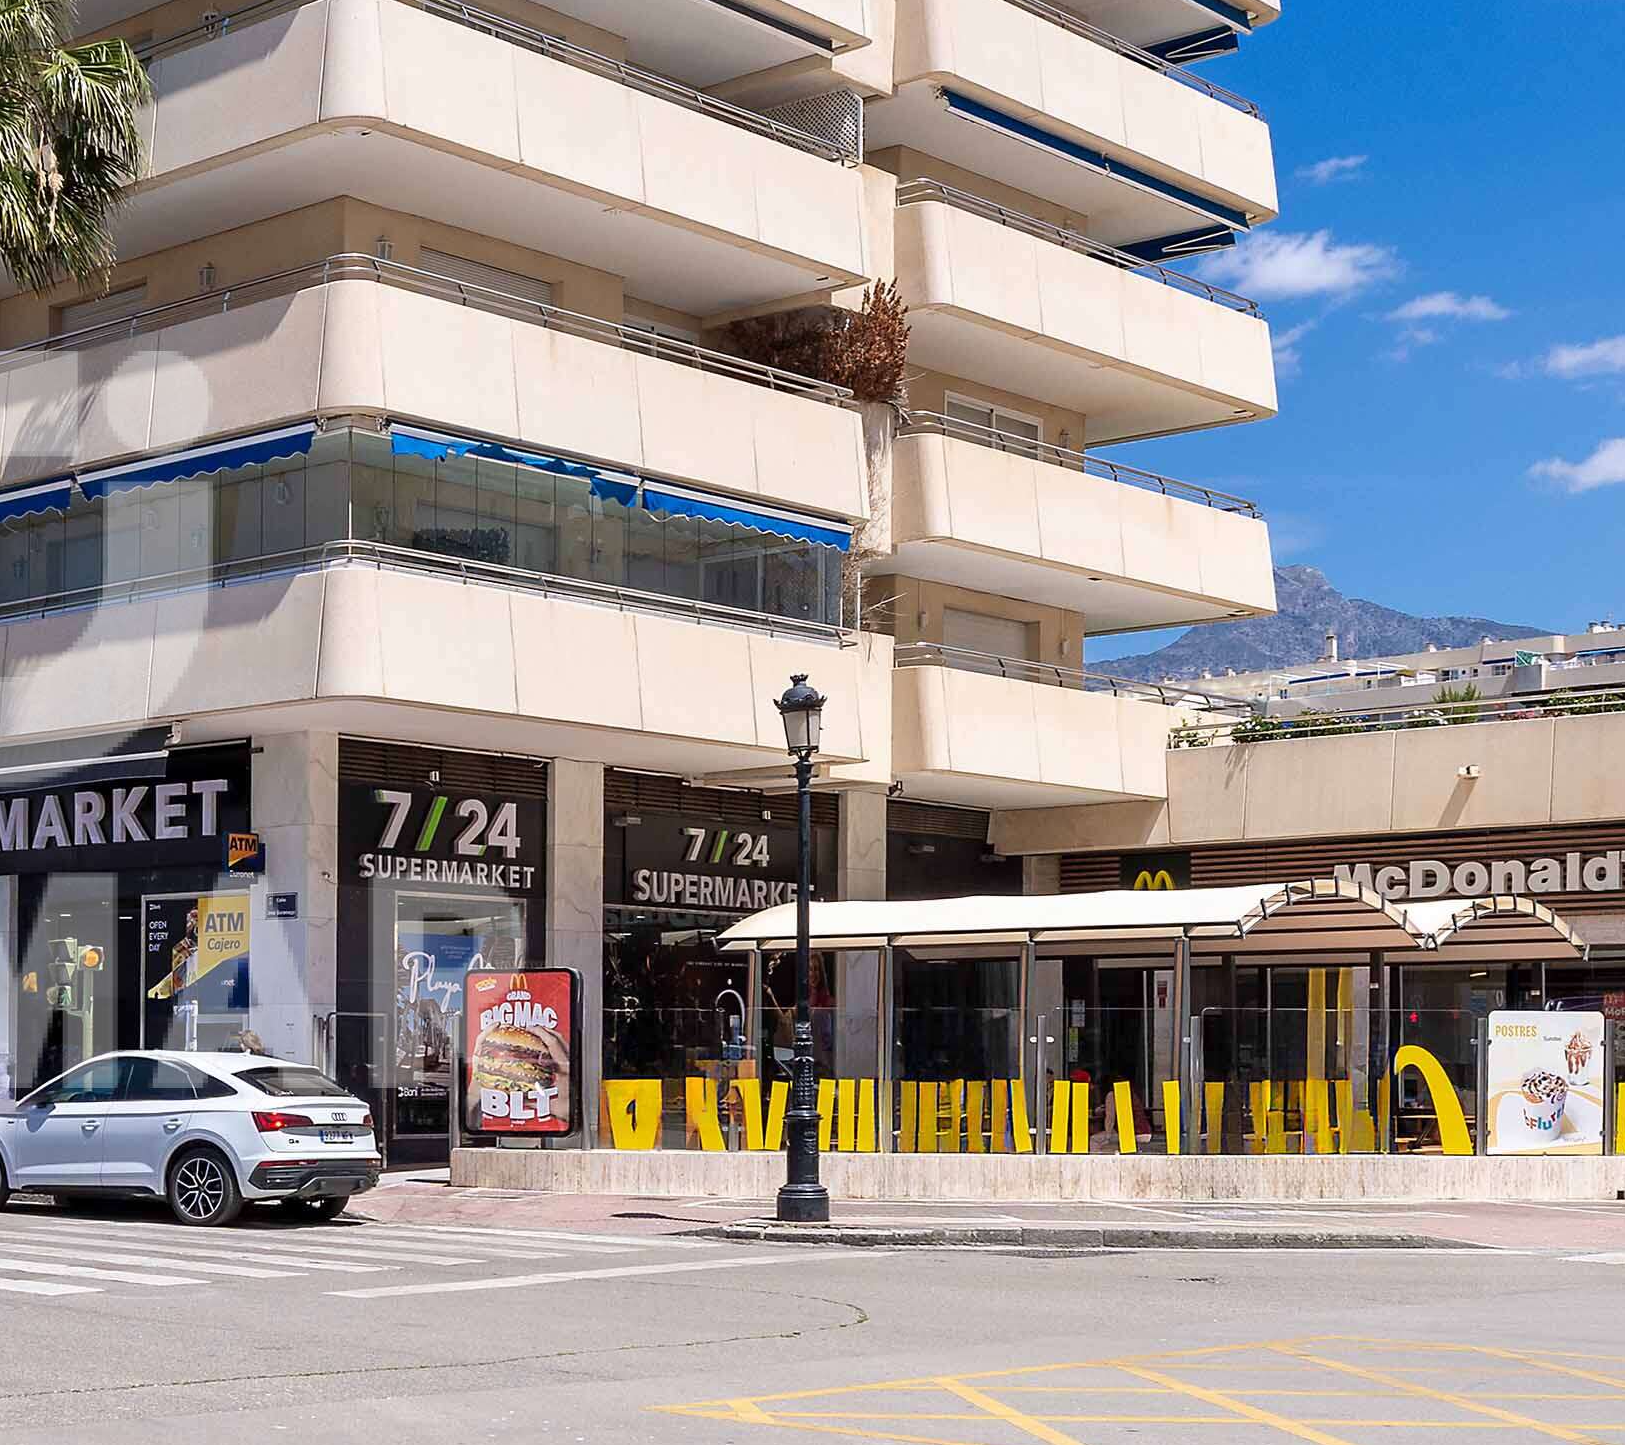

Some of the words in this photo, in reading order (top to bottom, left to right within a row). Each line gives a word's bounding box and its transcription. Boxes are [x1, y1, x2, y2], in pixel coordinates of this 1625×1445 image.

[230, 837, 257, 852] ATM
[359, 853, 535, 888] SUPERMARKET
[634, 869, 814, 909] SUPERMARKE
[149, 921, 167, 930] OPEN
[205, 912, 245, 933] ATM
[149, 932, 169, 941] EVERY
[148, 944, 161, 952] DAY
[207, 937, 241, 952] Cajero
[479, 1002, 514, 1030] BIG
[513, 1001, 559, 1030] MAC
[1495, 1024, 1538, 1038] POSTRES
[480, 1086, 559, 1121] BLT
